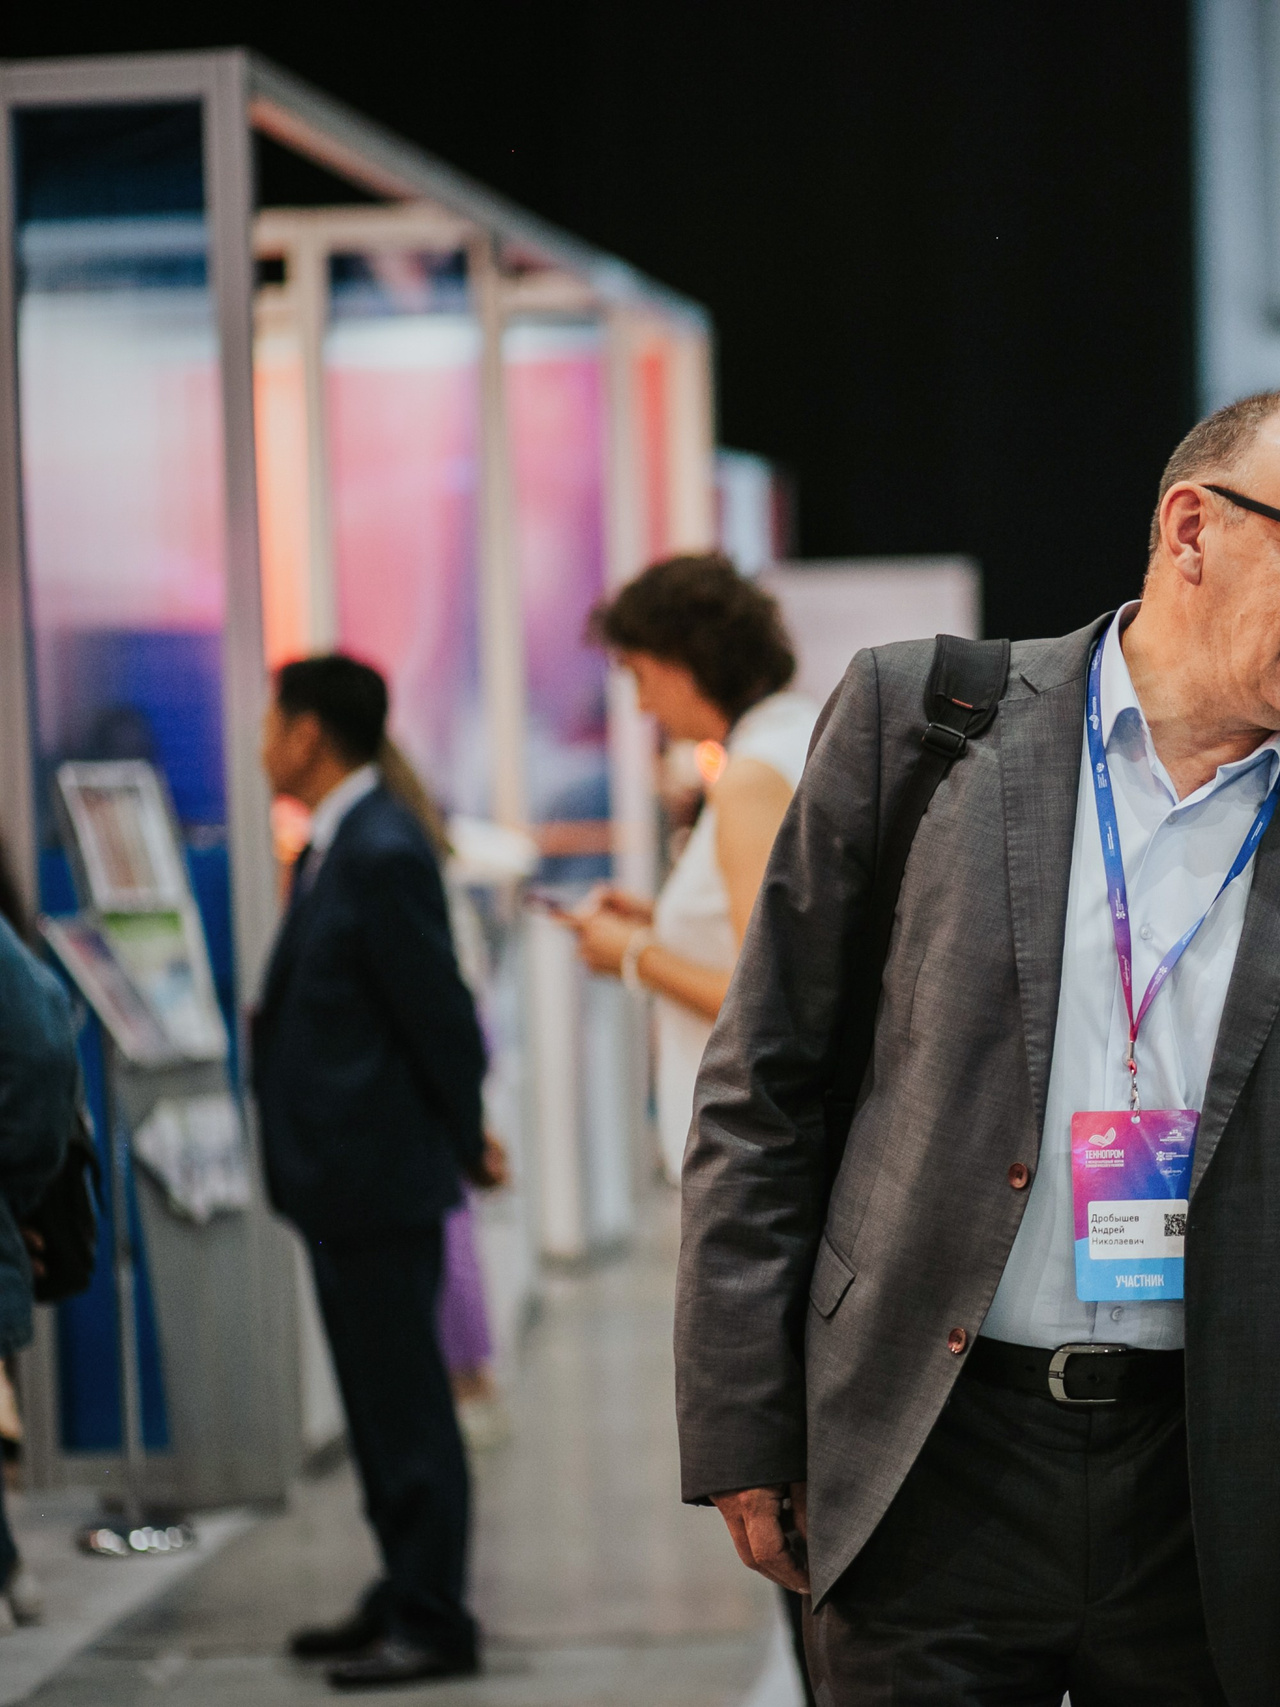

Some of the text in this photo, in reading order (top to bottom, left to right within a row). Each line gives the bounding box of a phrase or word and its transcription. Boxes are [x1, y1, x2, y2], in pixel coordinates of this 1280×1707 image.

[1085, 1149, 1125, 1159] ТЕХНОПРОМ
[1091, 1213, 1140, 1223] Дробышев
[1091, 1225, 1125, 1235] Андрей
[1091, 1238, 1144, 1246] Николаевич
[1115, 1274, 1165, 1288] УЧАСТНИК
